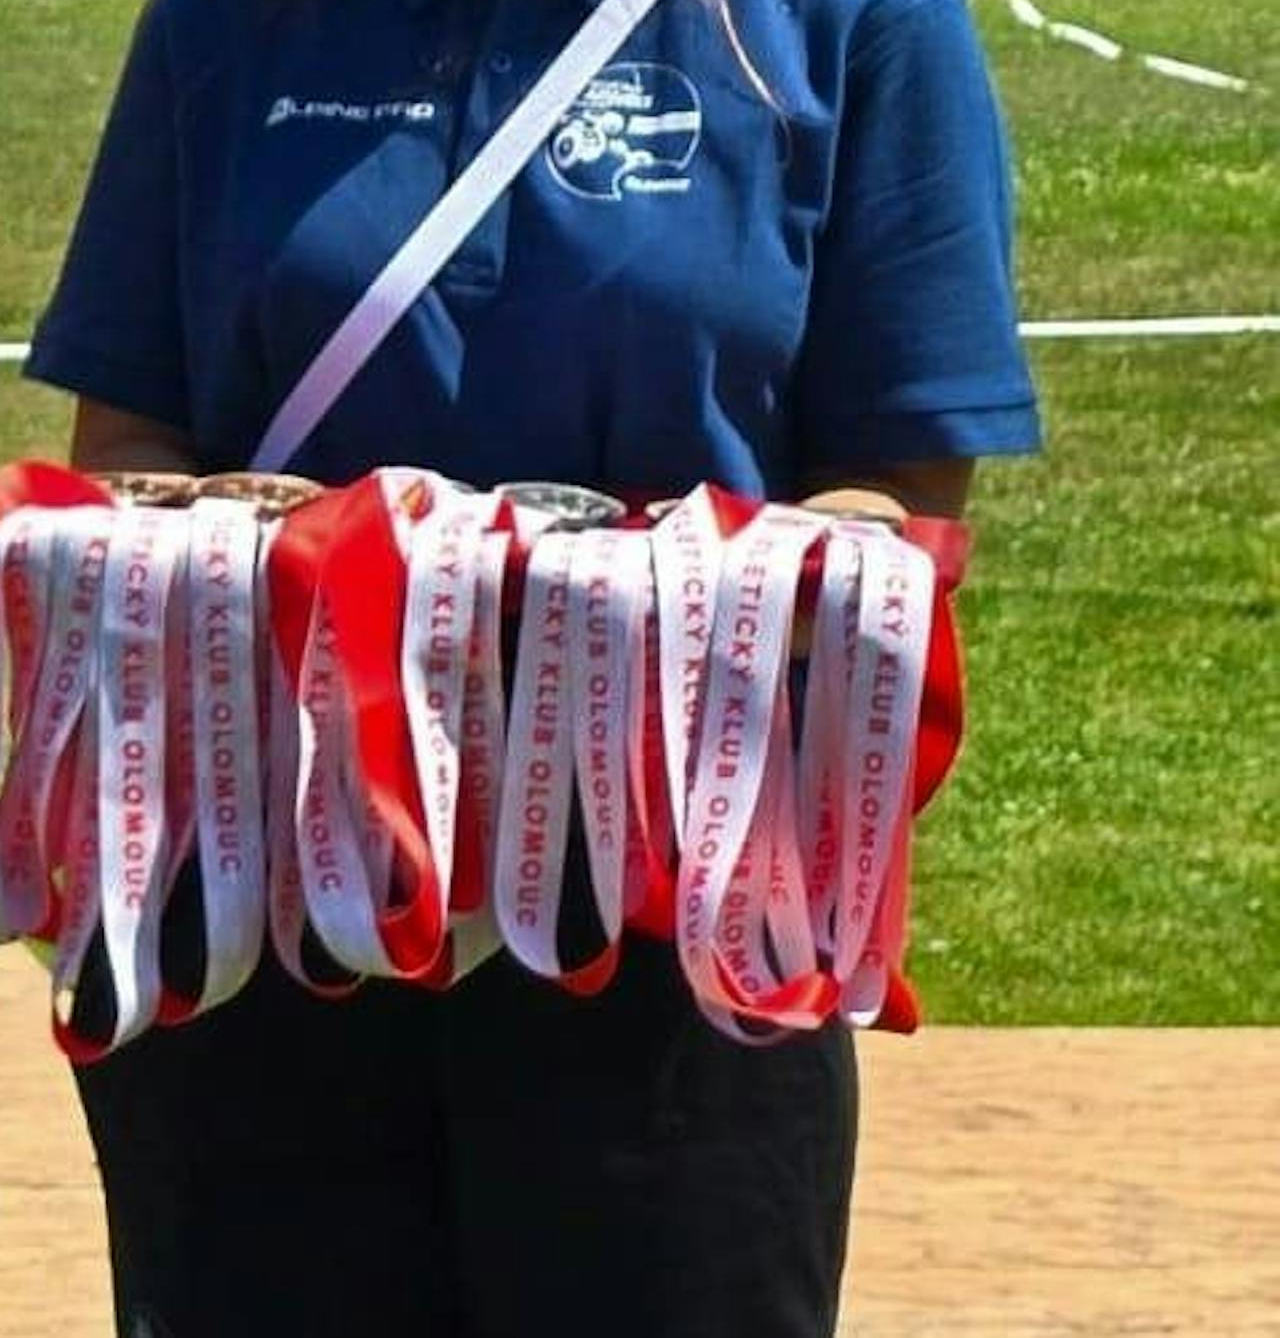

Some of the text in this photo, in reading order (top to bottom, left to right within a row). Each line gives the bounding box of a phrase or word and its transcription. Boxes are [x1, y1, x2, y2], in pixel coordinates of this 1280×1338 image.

[121, 642, 150, 722] KLUB
[207, 602, 232, 685] KLUB
[428, 592, 454, 673] KLUB
[532, 662, 560, 745] KLUB
[589, 674, 615, 852] OLOMOUC
[716, 694, 746, 779] KLUB
[121, 738, 146, 912] OLOMOUC
[209, 702, 243, 878] OLOMOUC
[516, 758, 552, 929] OLOMOUC
[850, 751, 884, 925] OLOMOUC
